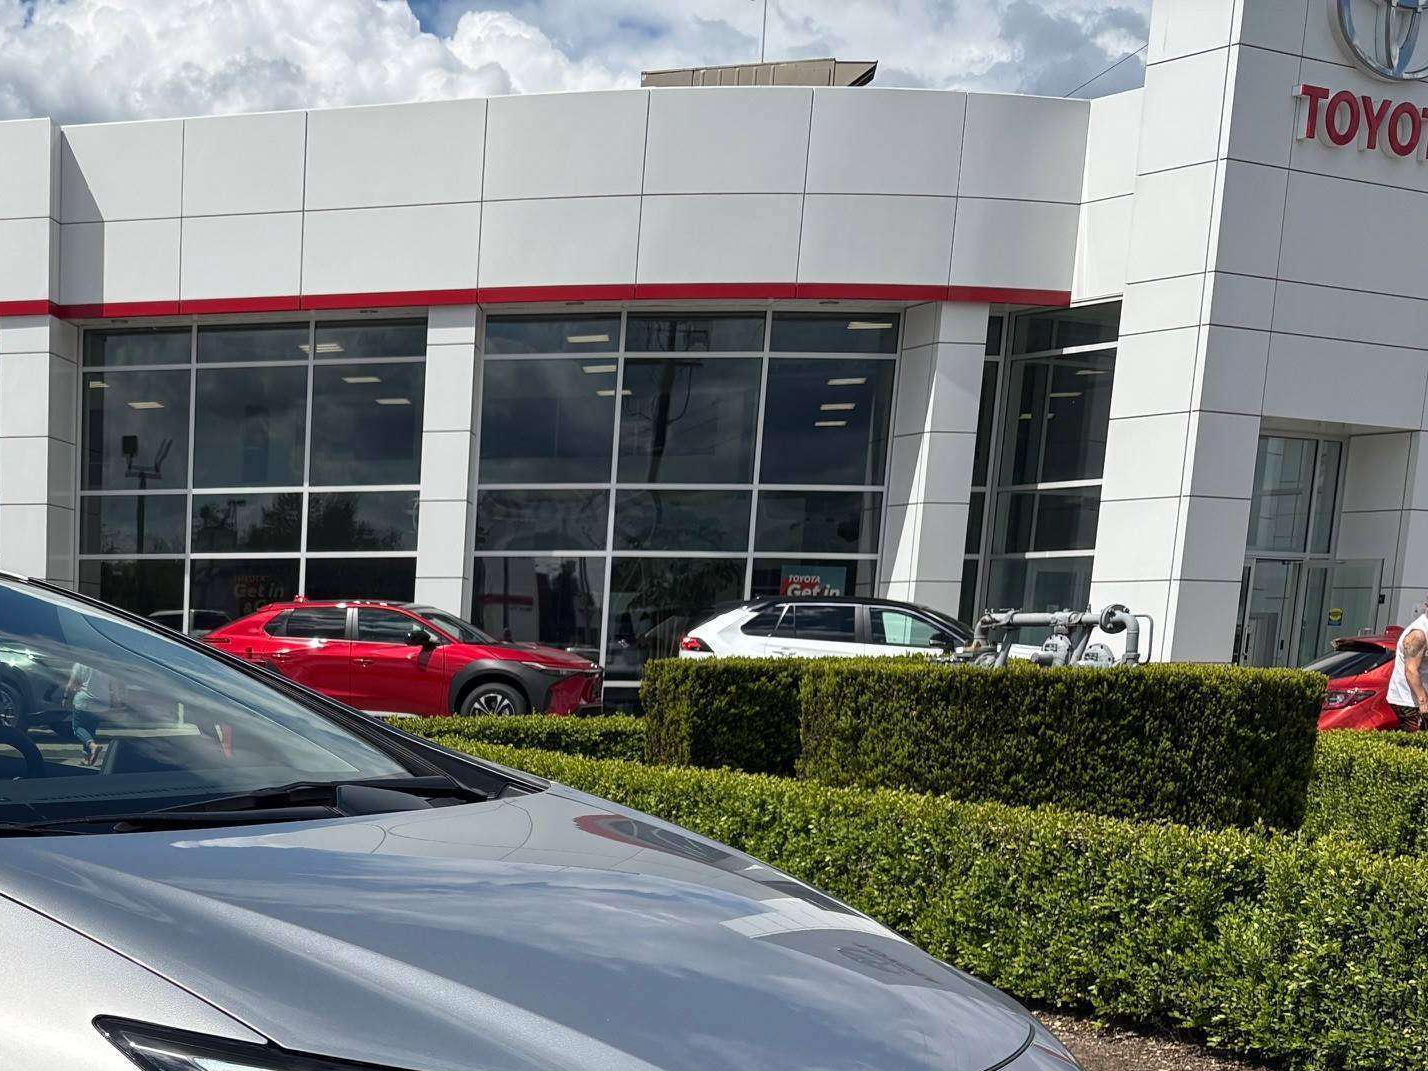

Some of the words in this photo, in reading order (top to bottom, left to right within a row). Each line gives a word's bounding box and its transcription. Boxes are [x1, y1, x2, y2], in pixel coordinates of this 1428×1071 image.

[1299, 84, 1428, 160] TOYO
[788, 574, 821, 583] TOYOTA
[787, 584, 821, 597] Get
[824, 584, 840, 597] in
